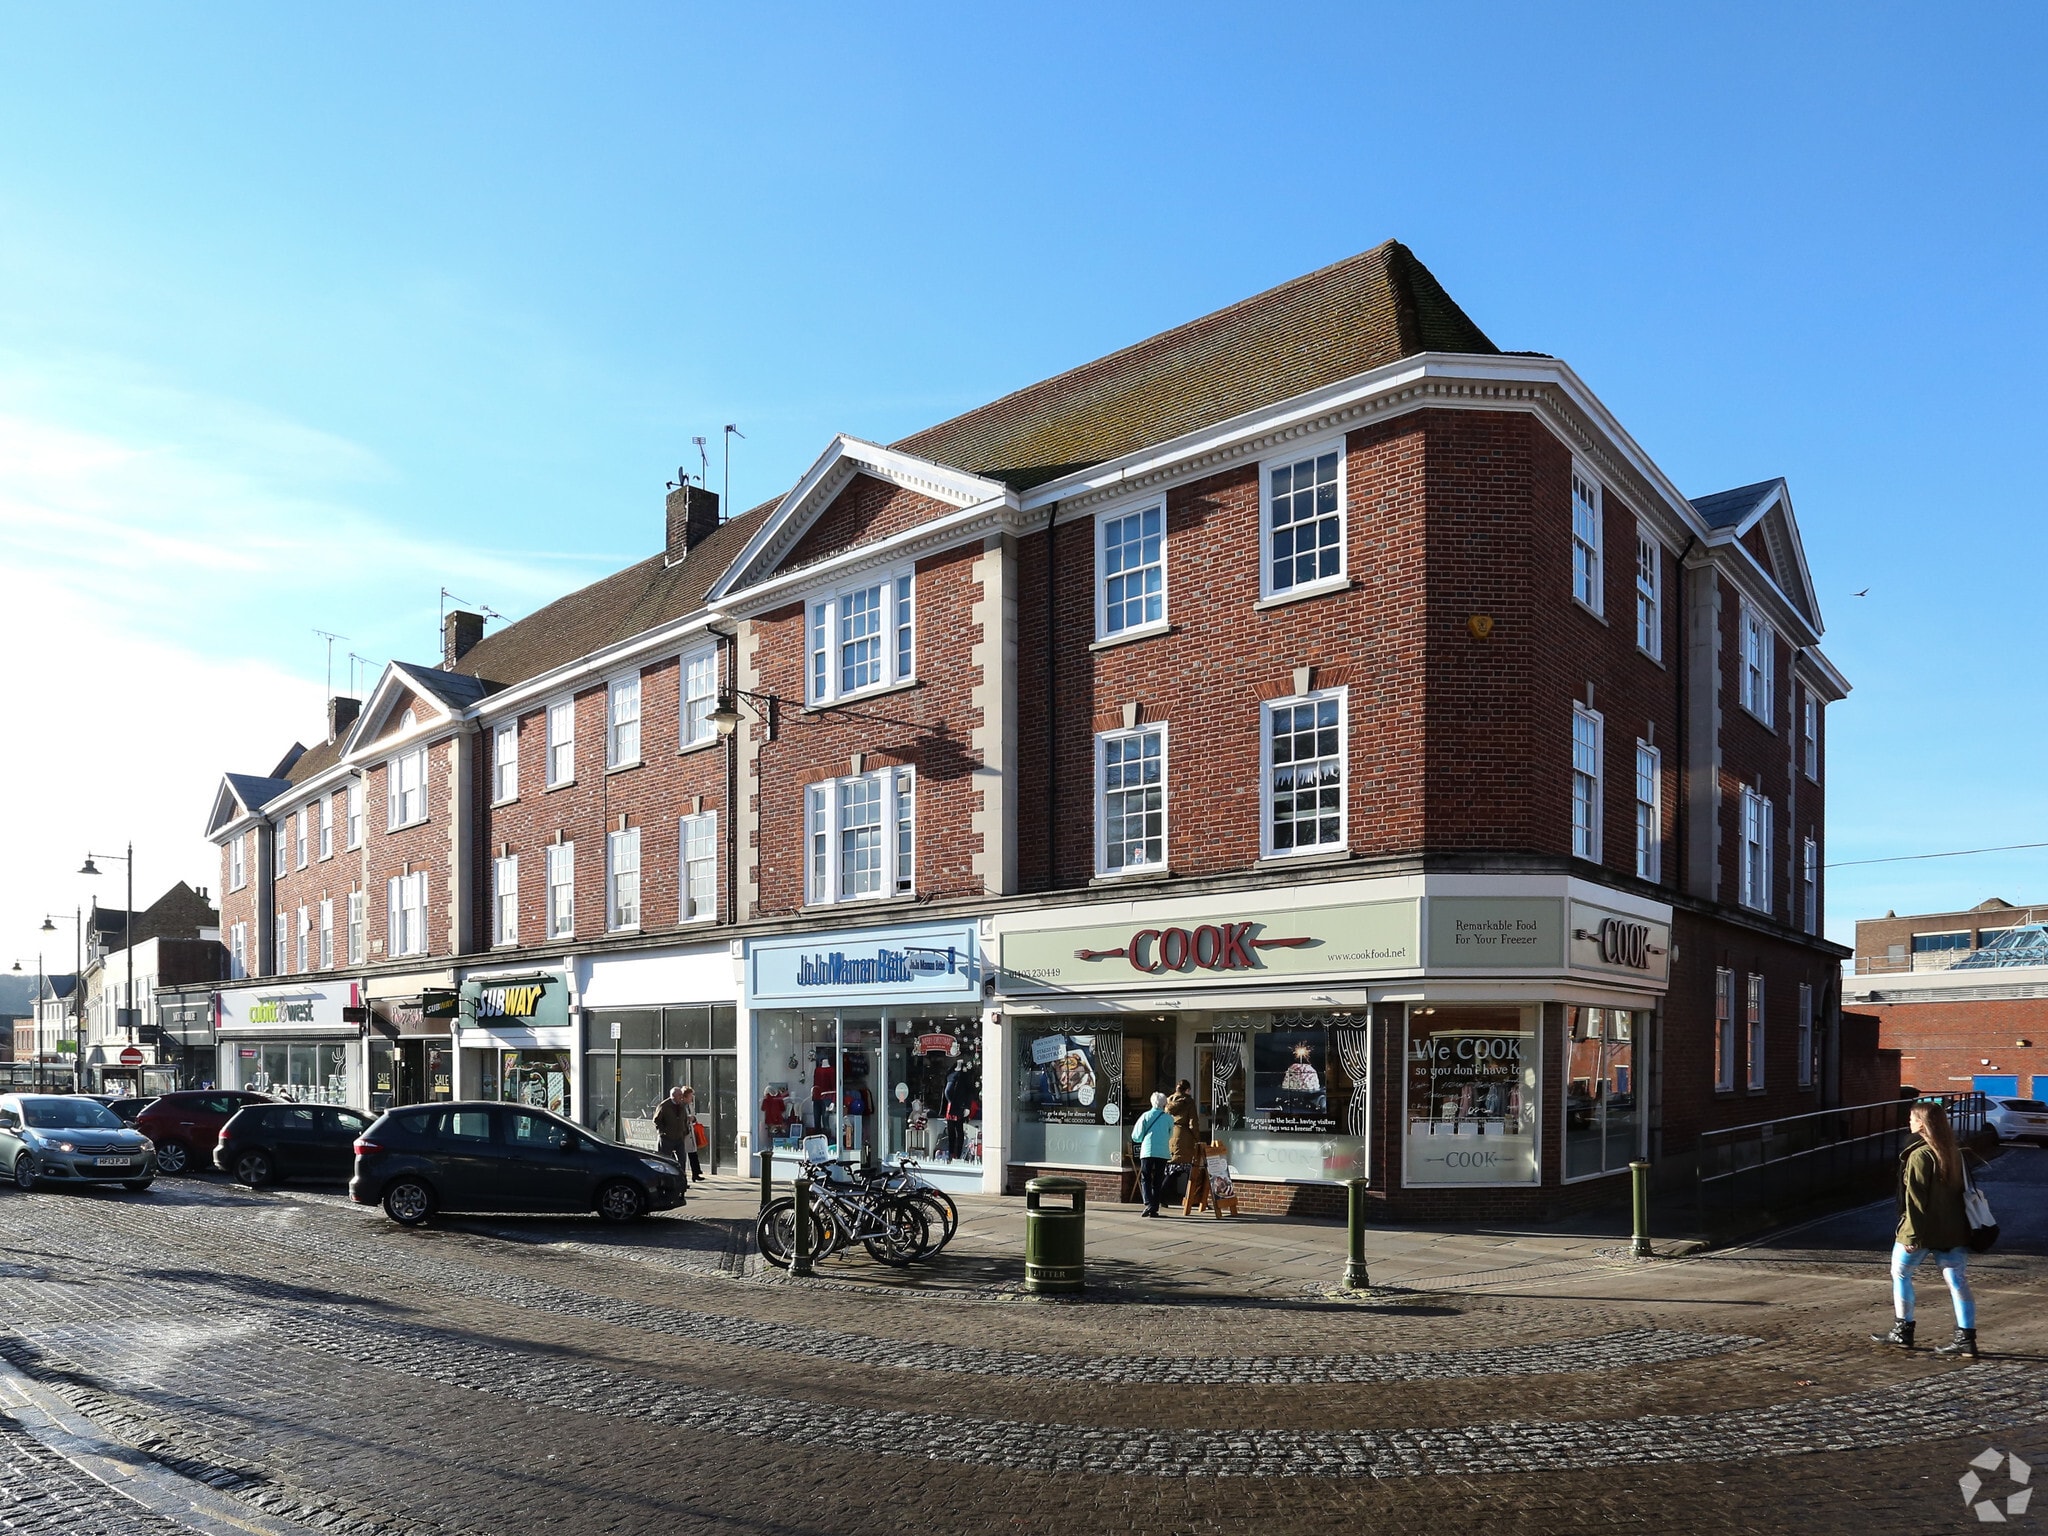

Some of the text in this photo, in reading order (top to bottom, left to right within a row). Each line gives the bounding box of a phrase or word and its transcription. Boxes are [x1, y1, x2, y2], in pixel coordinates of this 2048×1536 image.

[1456, 919, 1537, 931] Remarkable Food
[1129, 921, 1254, 972] COOK
[1455, 933, 1537, 945] For Your Freezer
[1602, 917, 1652, 969] COOK
[1327, 947, 1406, 962] www.cookfood.net
[426, 998, 456, 1014] SUBWAY
[477, 984, 544, 1018] SUBWAY
[249, 1001, 278, 1024] cubitt
[287, 1000, 314, 1022] west
[1413, 1038, 1451, 1061] We
[377, 1072, 391, 1084] SALE
[1415, 1066, 1427, 1076] so
[1430, 1067, 1451, 1080] you
[1453, 1063, 1480, 1076] don't
[1483, 1064, 1509, 1076] have
[434, 1074, 449, 1086] SALE
[1268, 1124, 1280, 1132] days
[1300, 1117, 1316, 1126] having
[1445, 1151, 1498, 1168] COOK
[1033, 1269, 1066, 1278] LITTER
